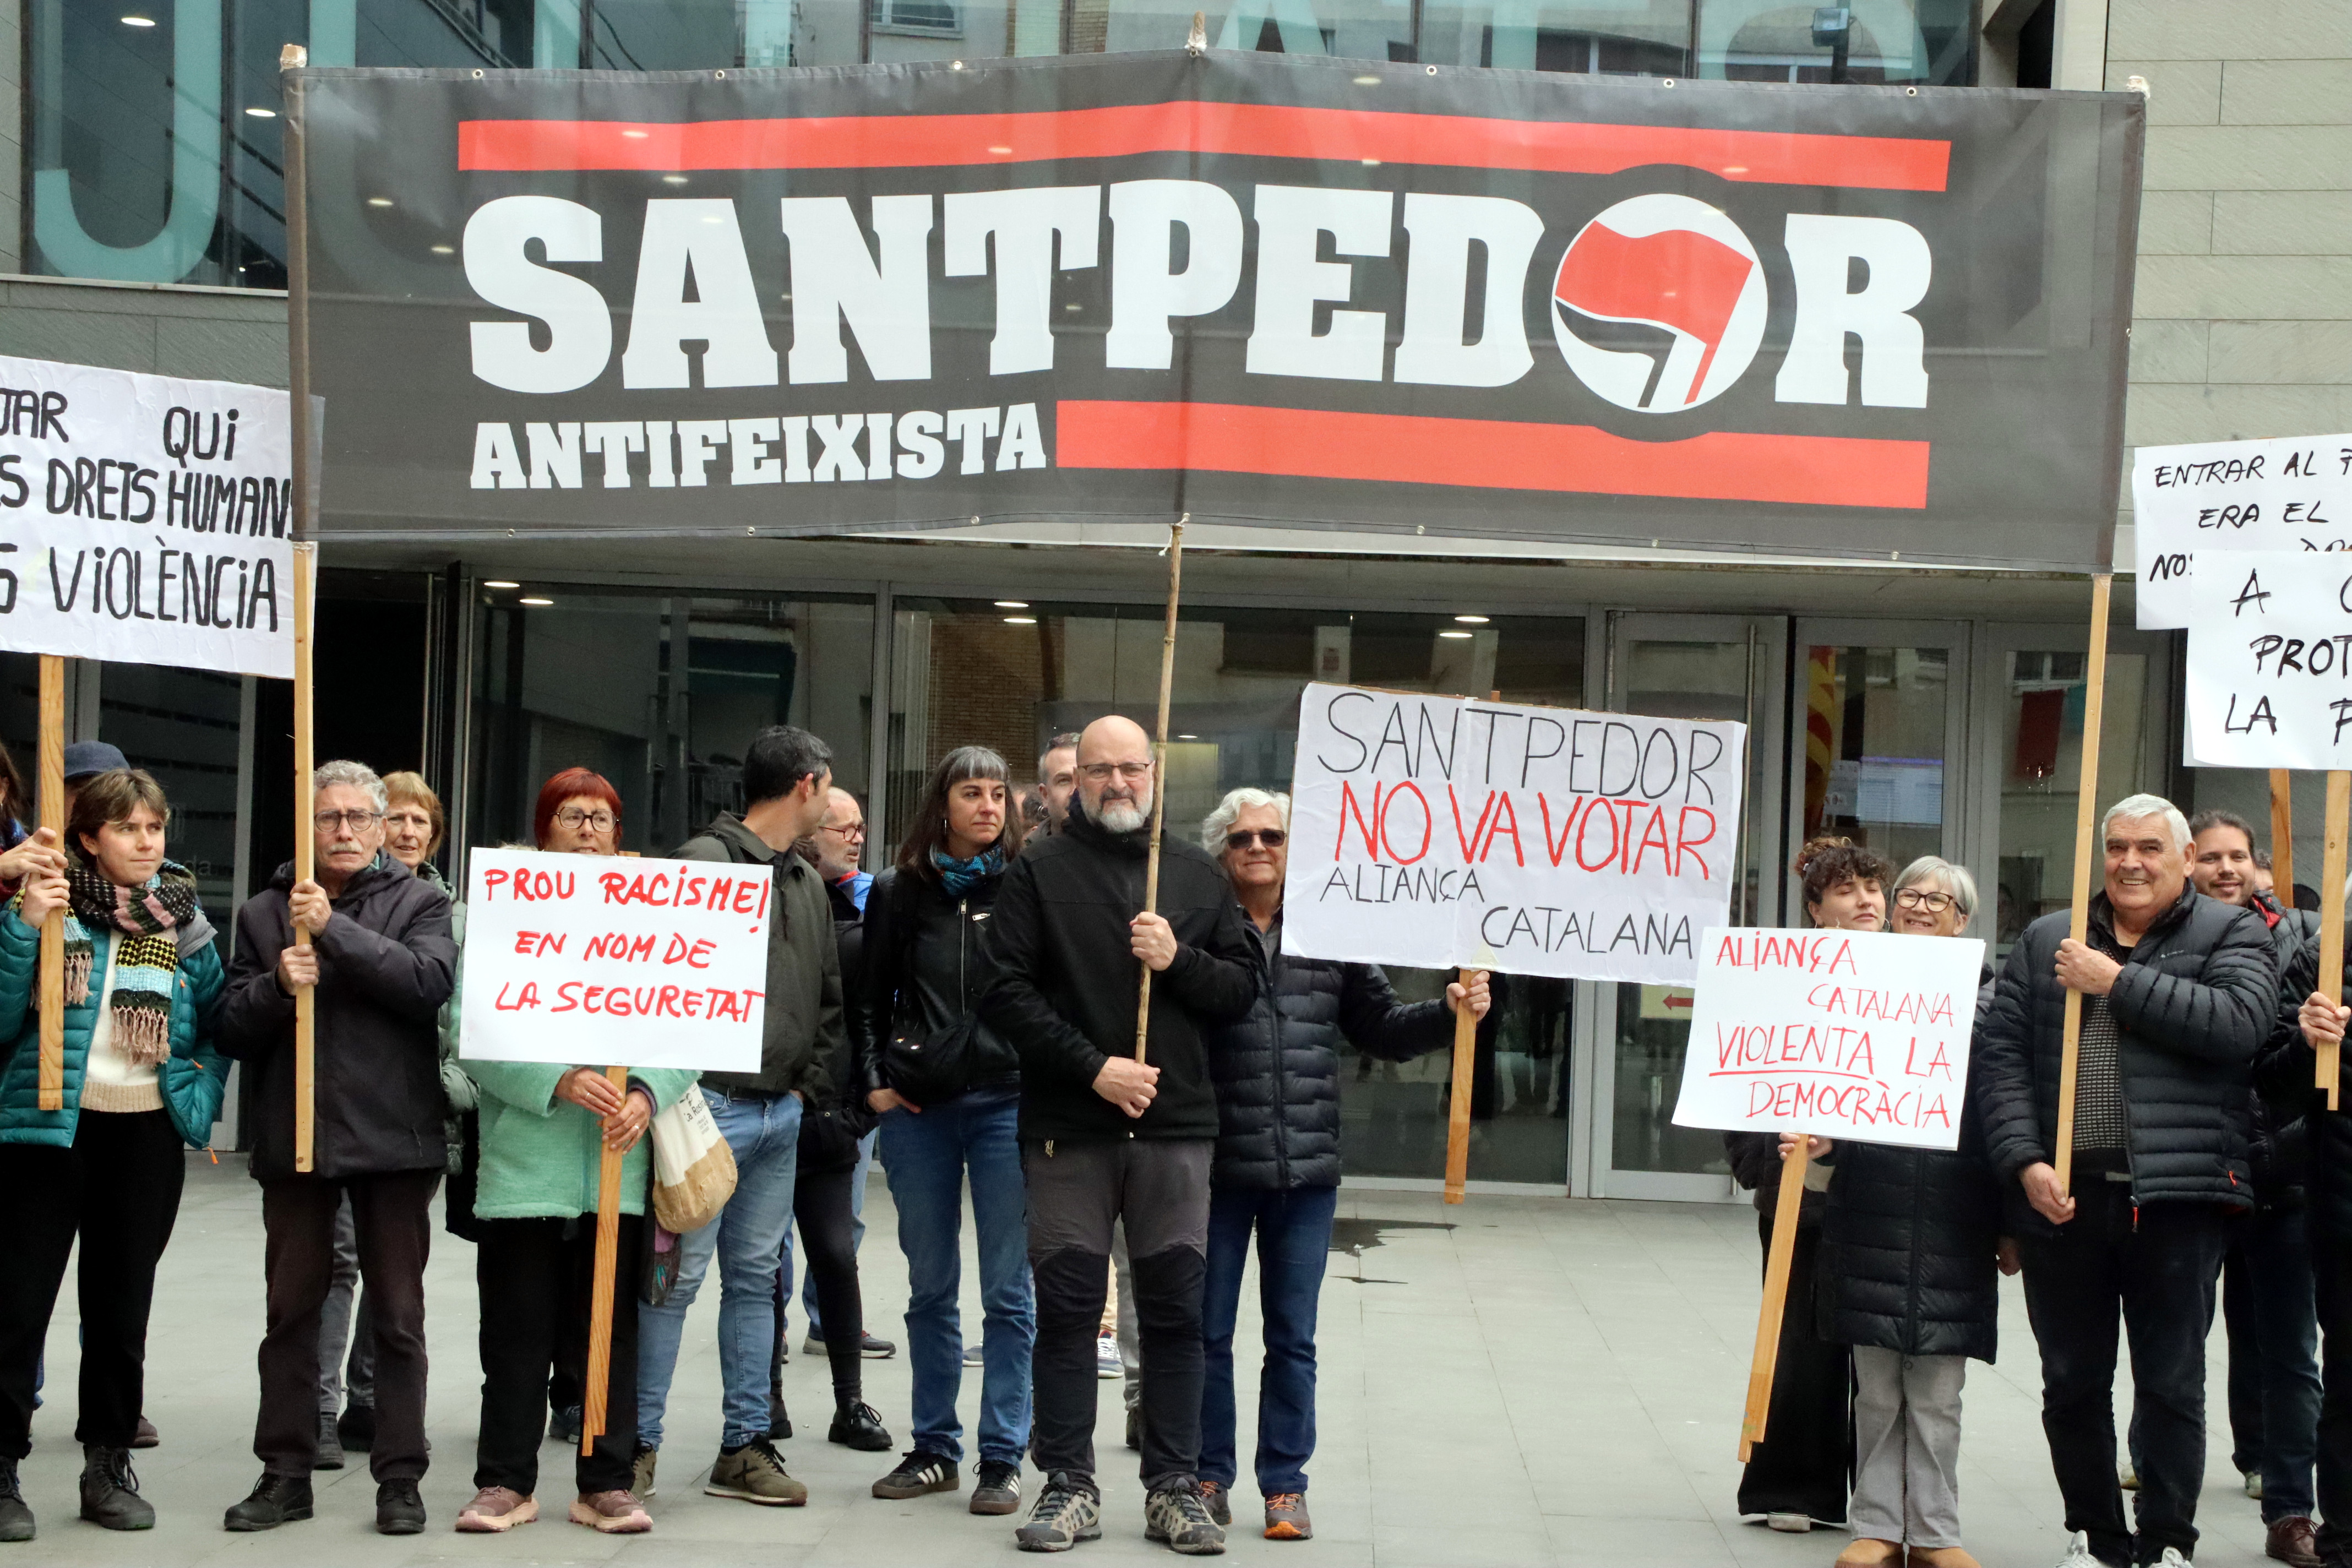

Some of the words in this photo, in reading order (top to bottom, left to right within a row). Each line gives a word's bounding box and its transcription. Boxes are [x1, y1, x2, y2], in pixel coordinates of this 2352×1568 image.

[471, 402, 1046, 489] ANTIFEIXISTA
[2155, 455, 2264, 487] ENTRAR
[2284, 450, 2317, 477] AL
[46, 457, 159, 523] DRETS
[167, 470, 295, 541] HUMAN
[2198, 503, 2260, 529] ERA
[2283, 500, 2329, 522] EL
[2149, 553, 2192, 582] NO
[2230, 568, 2271, 617] A
[2225, 693, 2277, 736] LA
[1317, 692, 1723, 805] SANTPEDOR
[1335, 780, 1432, 866] NO
[1448, 783, 1525, 868] VA
[1537, 791, 1717, 881] VOTAR
[484, 867, 575, 902] PROU
[1320, 864, 1485, 903] ALIANÇA
[514, 930, 568, 958] EN
[583, 932, 657, 963] NOM
[662, 932, 717, 969] DE
[1480, 906, 1693, 960] CATALANA
[495, 981, 542, 1011] LA
[550, 980, 766, 1023] SEGURETAT
[1807, 983, 1954, 1027] CATALANA
[1904, 1036, 1952, 1082] LA
